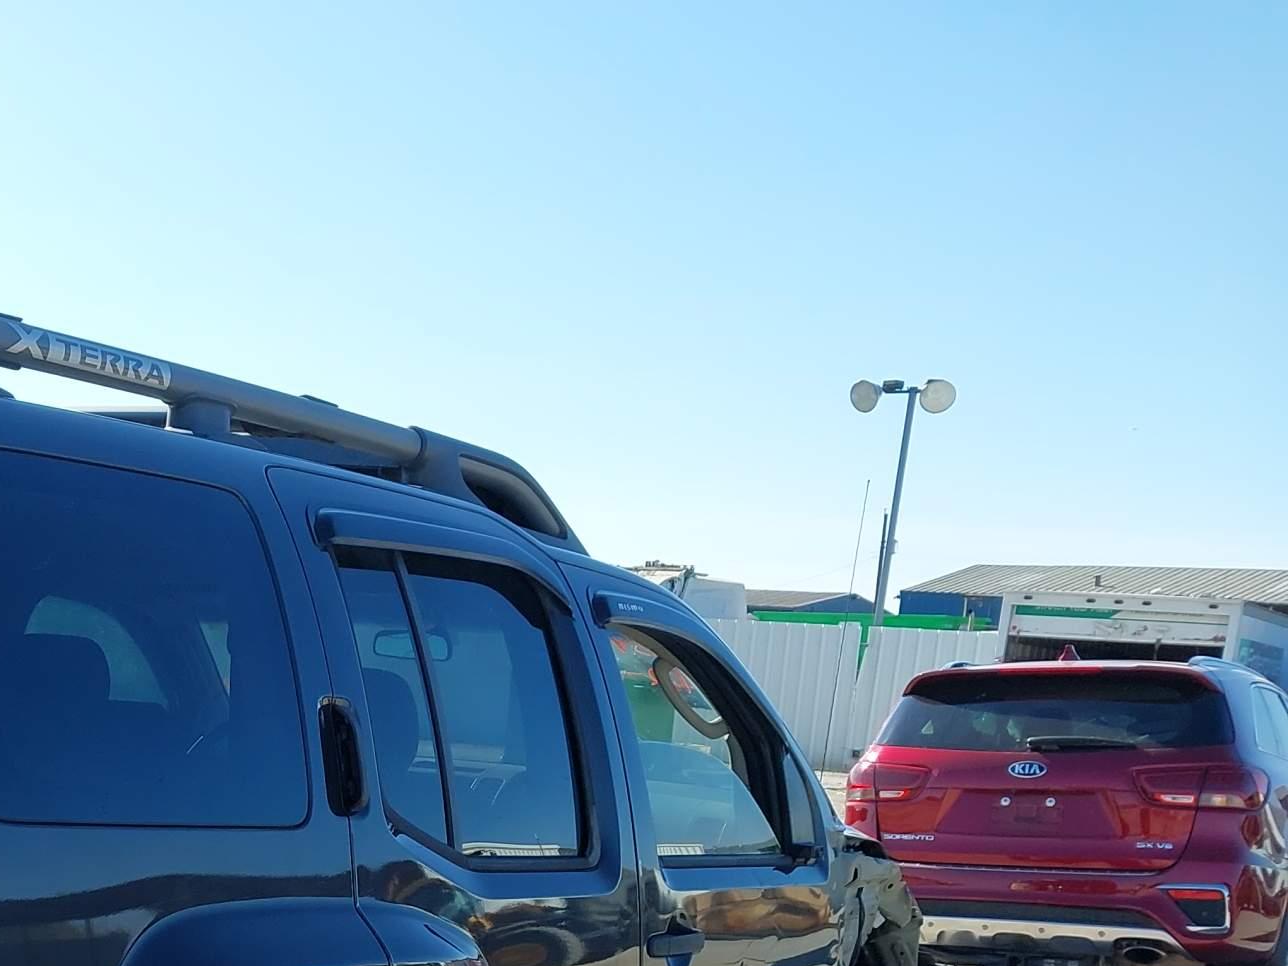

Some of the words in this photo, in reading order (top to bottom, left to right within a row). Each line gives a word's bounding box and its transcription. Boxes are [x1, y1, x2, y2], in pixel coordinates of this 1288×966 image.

[6, 321, 172, 391] XTERRA
[1014, 763, 1041, 774] KIA
[882, 833, 935, 841] SORENTO
